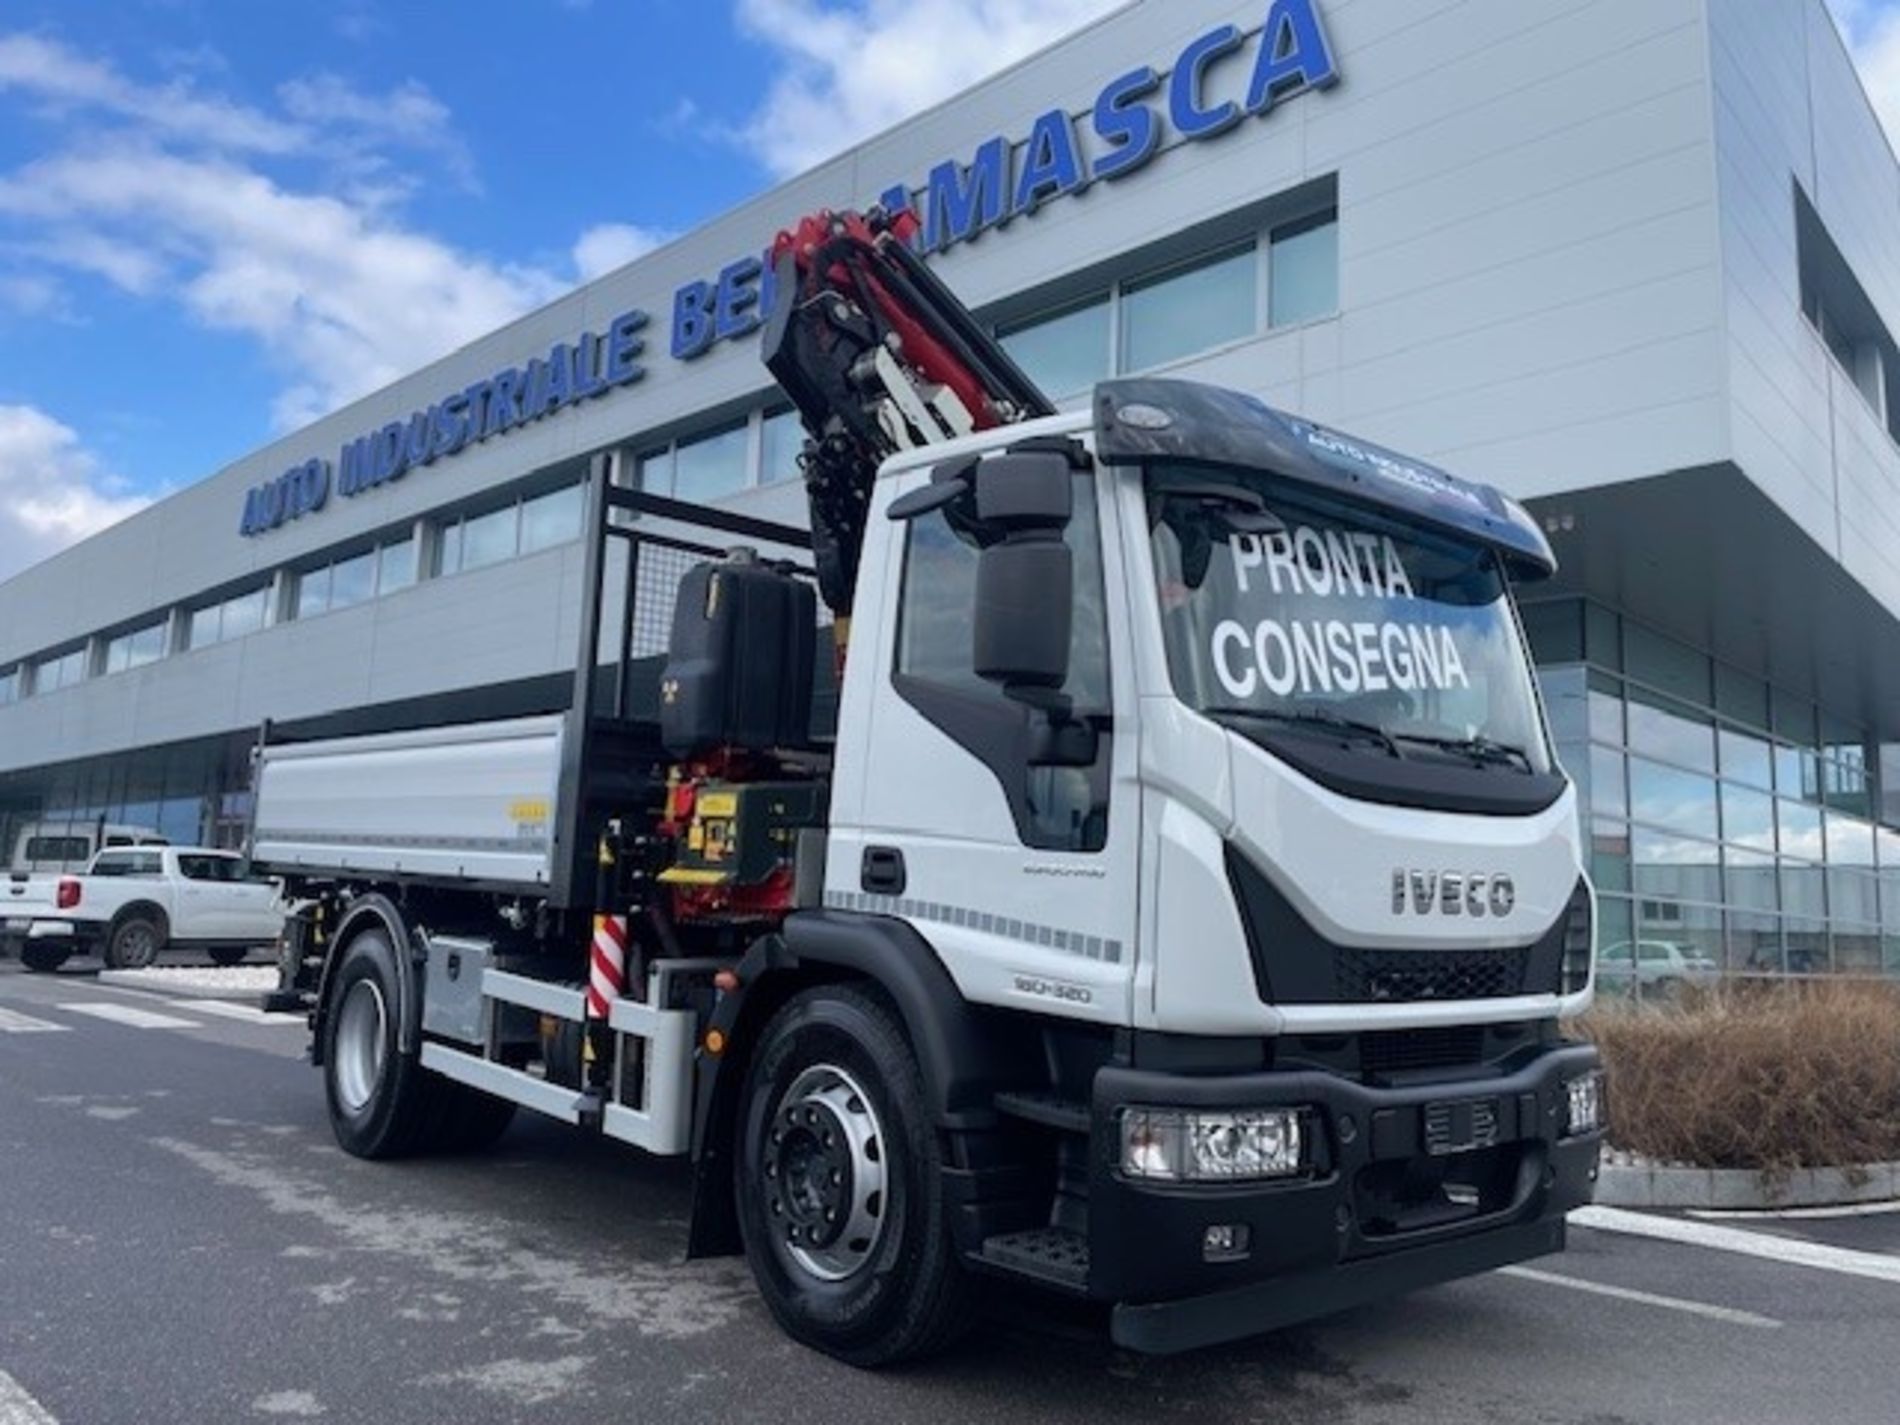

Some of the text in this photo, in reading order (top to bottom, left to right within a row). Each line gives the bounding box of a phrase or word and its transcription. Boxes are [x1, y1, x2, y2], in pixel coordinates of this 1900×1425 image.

[239, 0, 1342, 537] AUTO INDUSTRIALE BEMASCA
[1229, 526, 1414, 599] PRONTA
[1211, 619, 1471, 698] CONSEGNA
[1392, 866, 1515, 918] IVECO
